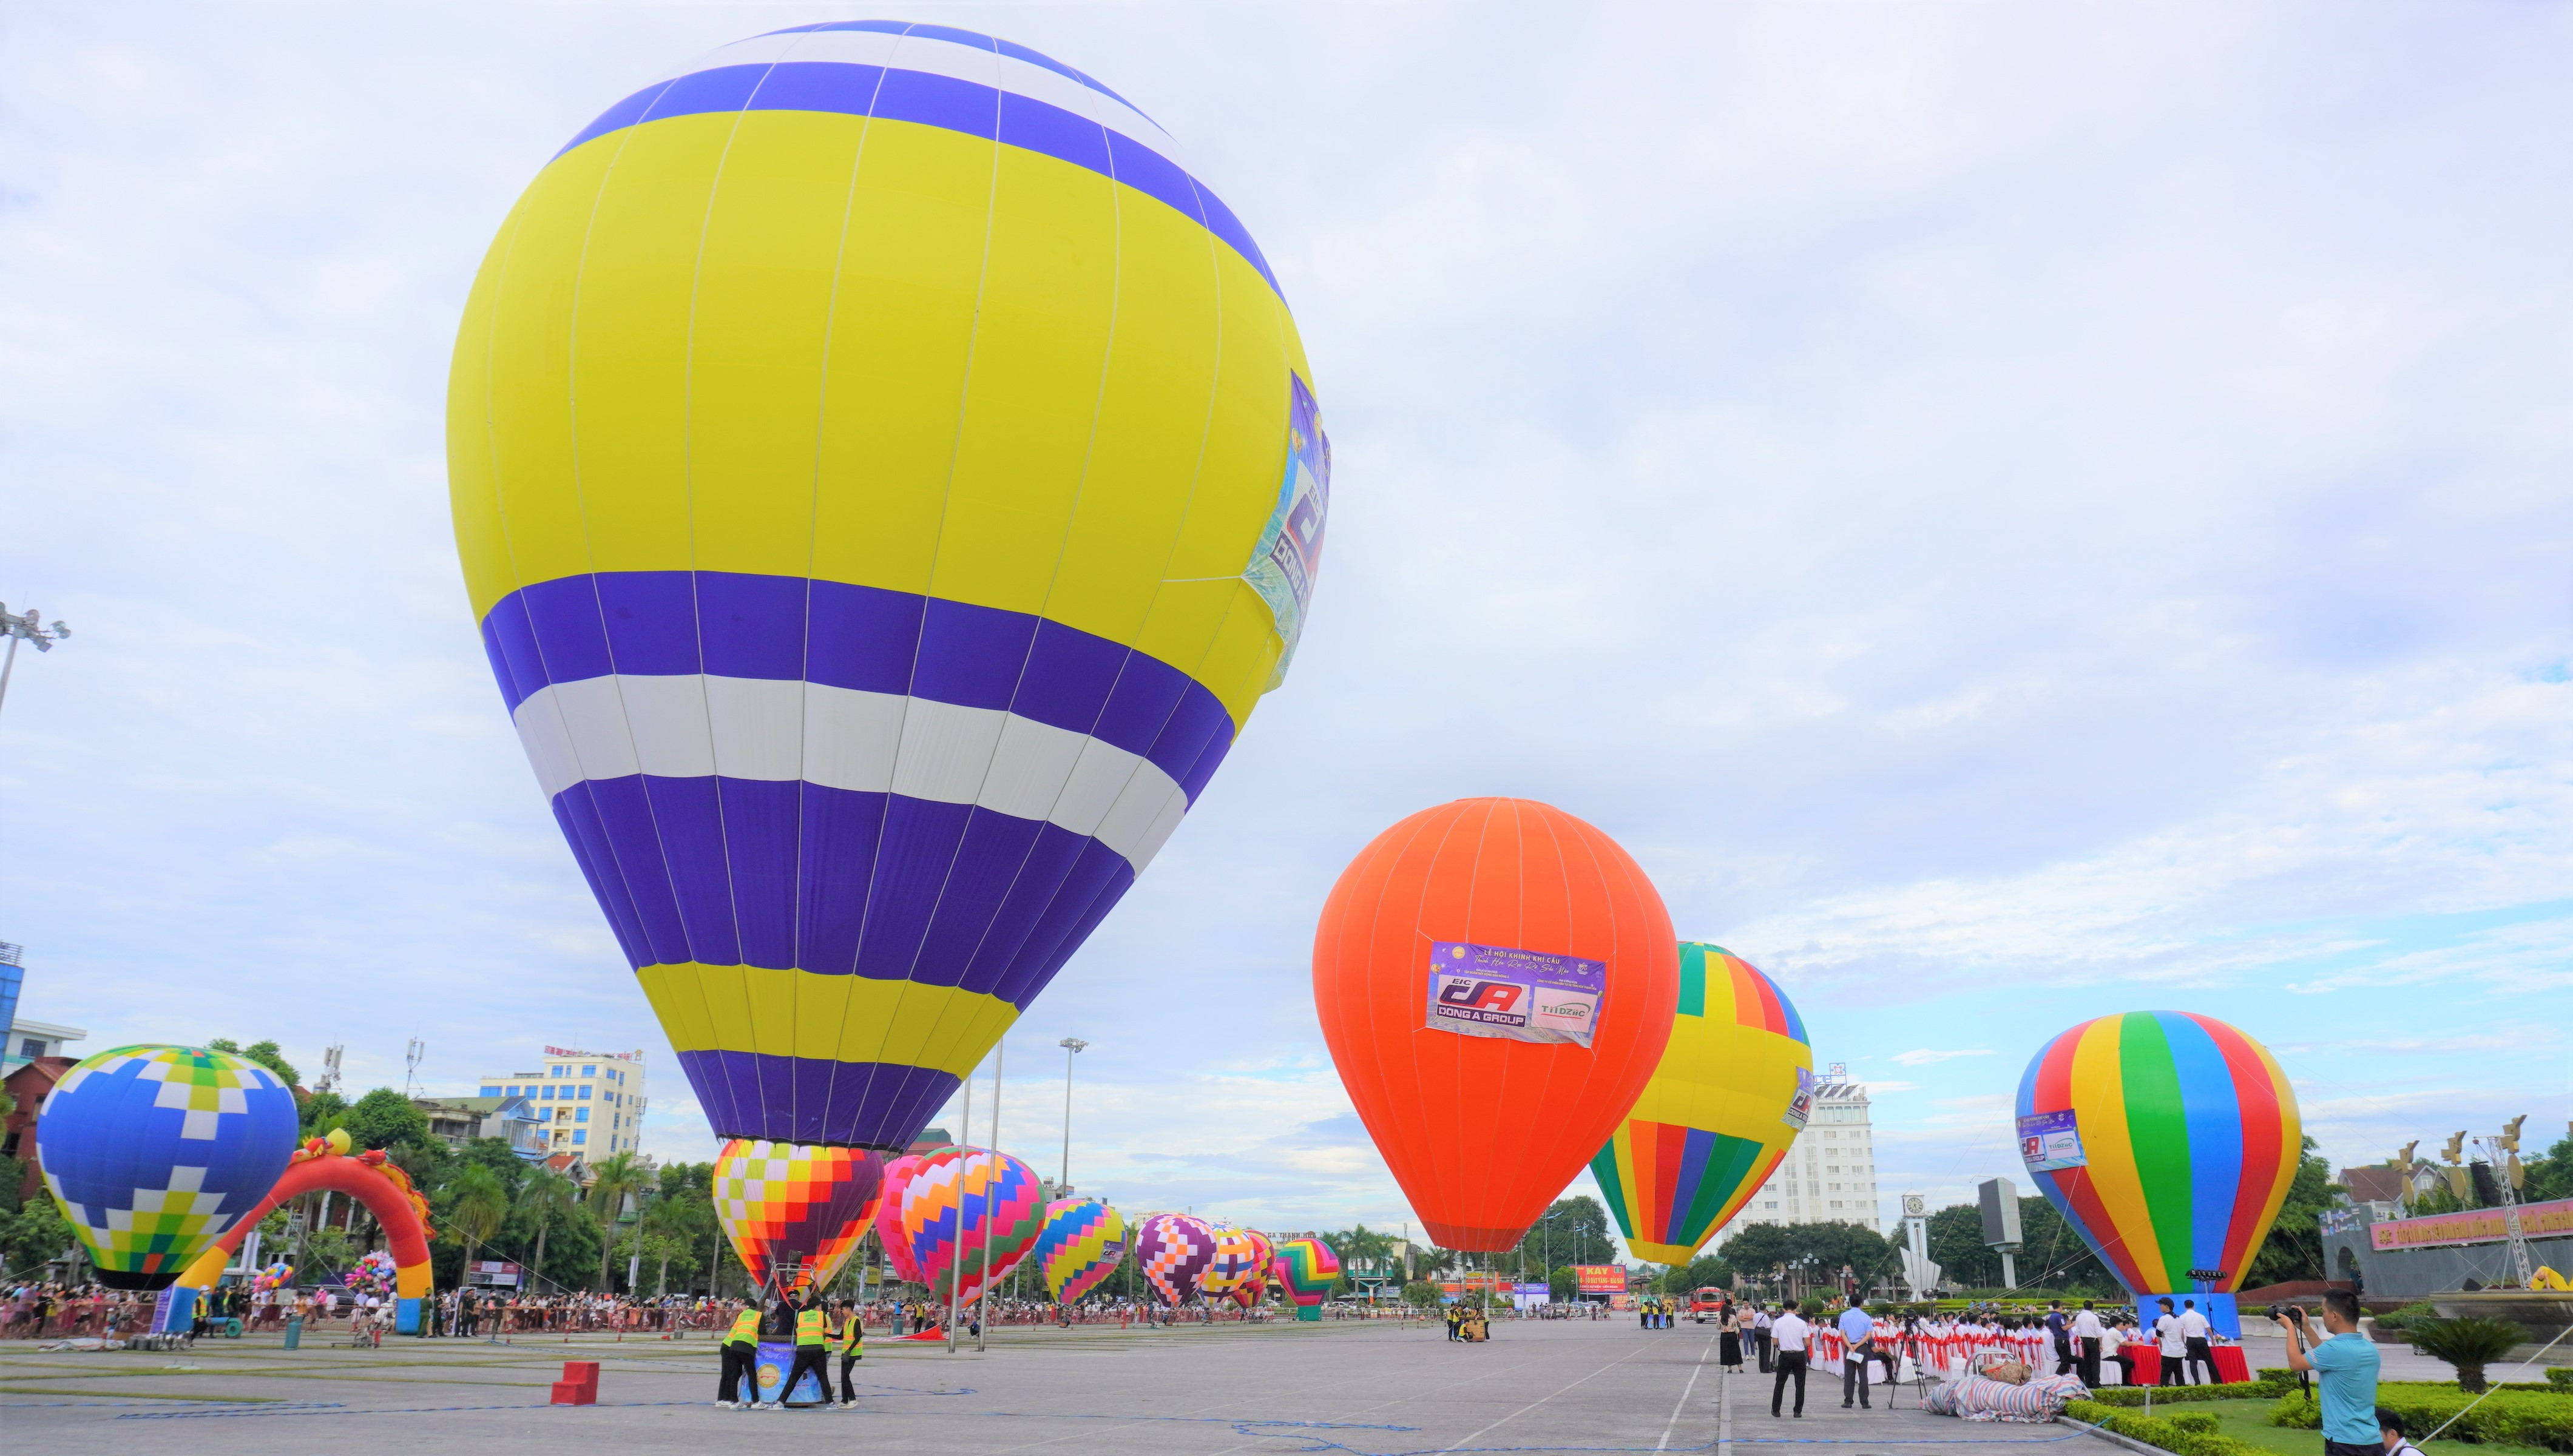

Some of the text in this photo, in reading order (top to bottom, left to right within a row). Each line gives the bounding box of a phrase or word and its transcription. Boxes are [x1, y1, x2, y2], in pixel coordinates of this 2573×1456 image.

[1308, 484, 1321, 513] EIC
[1509, 952, 1531, 961] KHINH
[1439, 1007, 1524, 1025] DONG A GROUP
